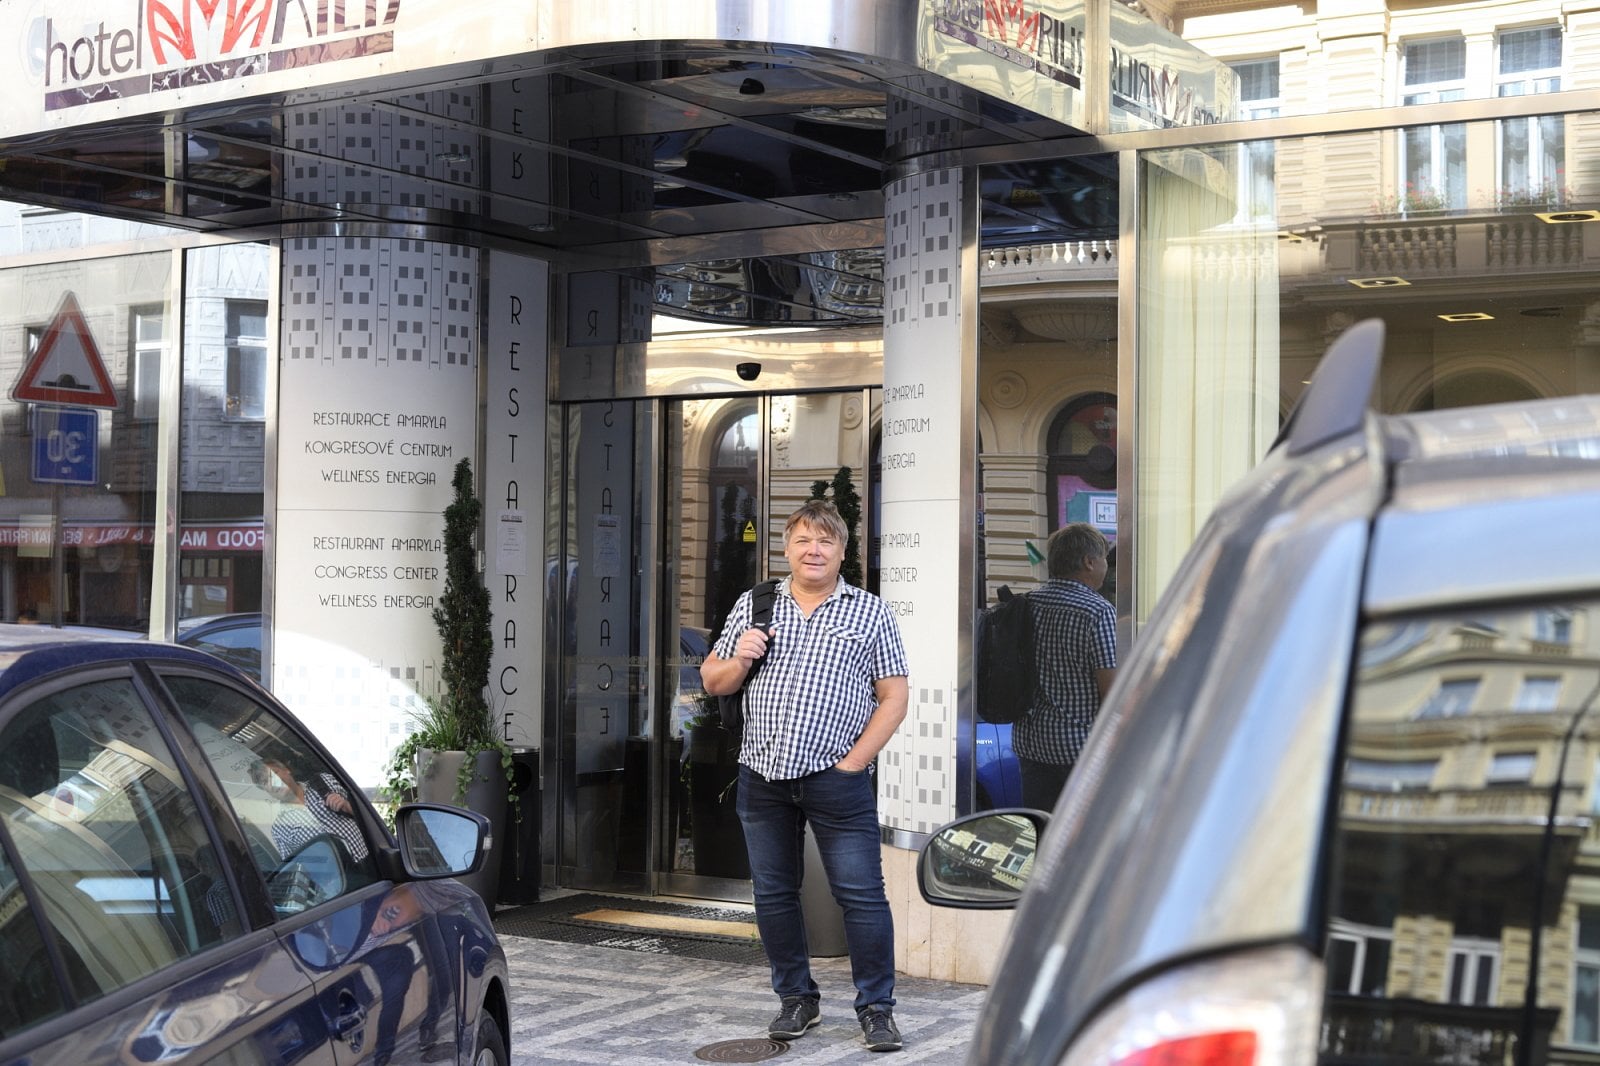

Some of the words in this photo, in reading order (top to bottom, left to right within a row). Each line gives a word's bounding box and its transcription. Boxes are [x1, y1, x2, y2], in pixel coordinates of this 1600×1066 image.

[45, 0, 142, 86] hotel
[892, 384, 924, 402] AMARYLA
[314, 412, 390, 426] RESTAURACE
[398, 414, 446, 429] AMARYLA
[893, 418, 930, 435] CENTRUM
[305, 440, 394, 456] KONGRESOVÉ
[401, 443, 452, 458] CENTRUM
[888, 452, 916, 470] ENERGIA
[322, 470, 380, 483] WELLNESS
[387, 471, 436, 484] ENERGIA
[500, 296, 522, 741] RESTARACE
[314, 537, 385, 550] RESTAURANT
[392, 538, 440, 552] AMARYLA
[889, 533, 919, 548] AMARYLA
[315, 565, 387, 579] CONGRESS
[394, 567, 438, 580] CENTER
[889, 567, 917, 582] CENTER
[319, 594, 377, 607] WELLNESS
[385, 596, 434, 609] ENERGIA
